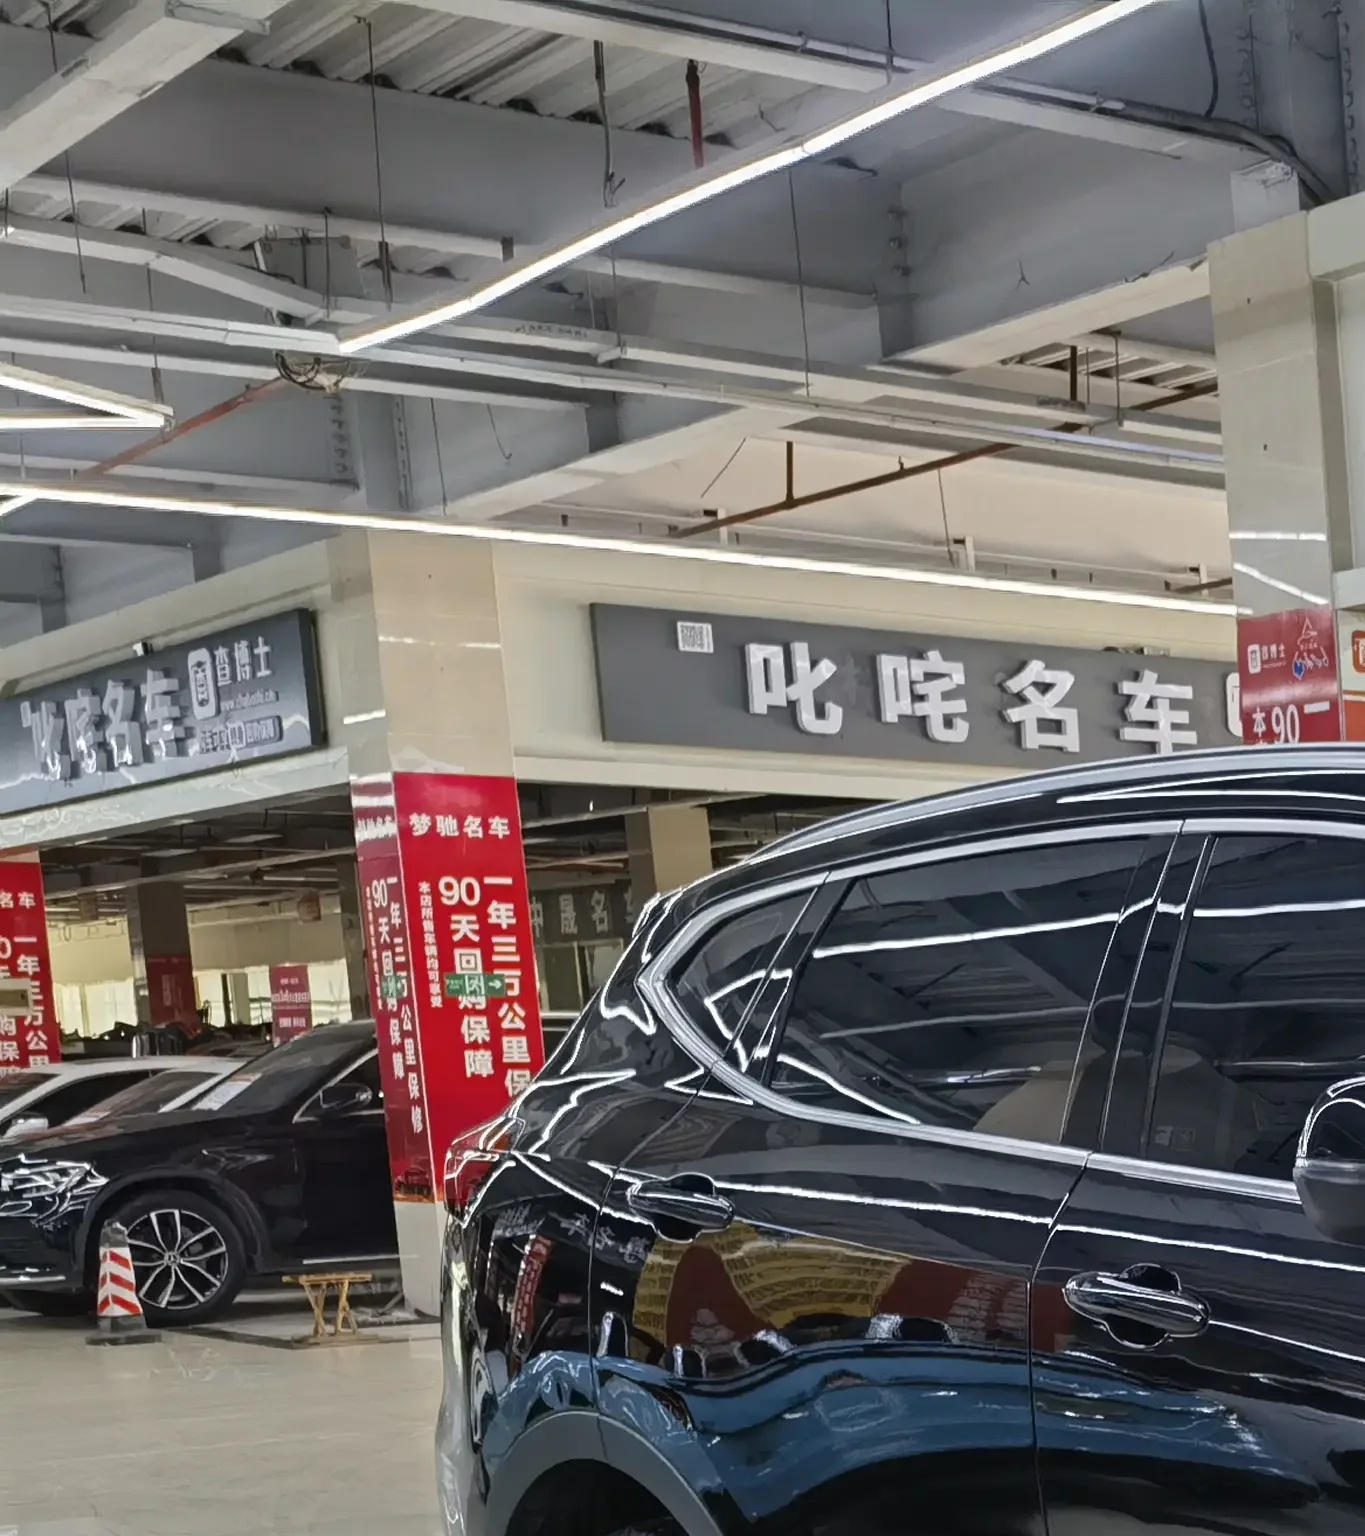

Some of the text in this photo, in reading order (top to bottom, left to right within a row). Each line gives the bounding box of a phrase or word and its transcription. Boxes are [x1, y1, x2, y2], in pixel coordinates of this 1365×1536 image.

[744, 641, 1198, 756] 叱咤名车
[1271, 703, 1300, 744] 90
[408, 813, 511, 839] 梦驰名车
